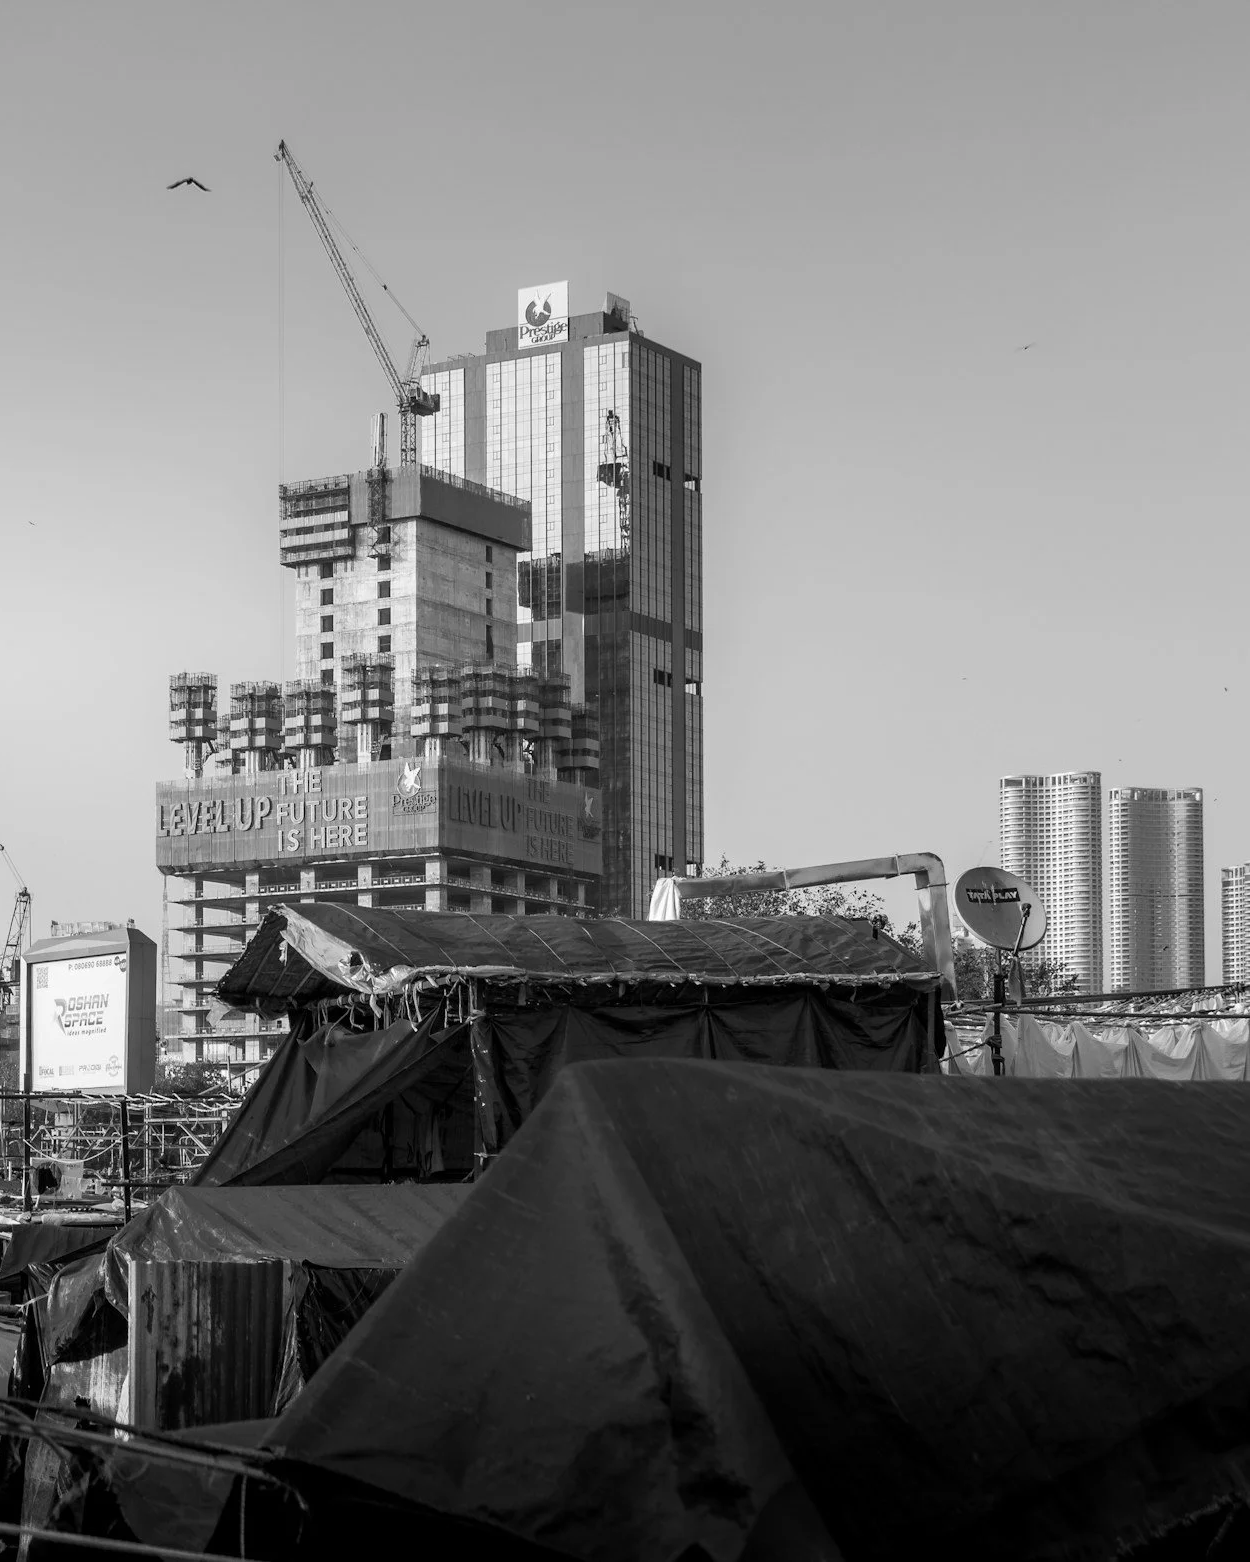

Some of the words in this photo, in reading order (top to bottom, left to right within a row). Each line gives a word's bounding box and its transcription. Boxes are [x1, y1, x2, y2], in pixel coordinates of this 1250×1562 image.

[519, 321, 568, 339] Prestige
[531, 333, 555, 344] GROUP
[277, 770, 323, 795] THE
[526, 777, 551, 804] THE
[276, 796, 368, 826] FUTURE
[393, 793, 437, 807] Prestige
[449, 784, 497, 828] LEVEL
[500, 794, 522, 833] UP
[158, 799, 231, 837] LEVEL
[235, 796, 272, 831] UP
[525, 806, 575, 838] FUTURE
[278, 829, 301, 851] IS
[310, 823, 368, 850] HERE
[540, 837, 575, 865] HERE
[967, 890, 992, 901] TATA
[991, 890, 1018, 901] PLAY
[64, 1010, 104, 1028] SPACE
[81, 1026, 107, 1037] magnified
